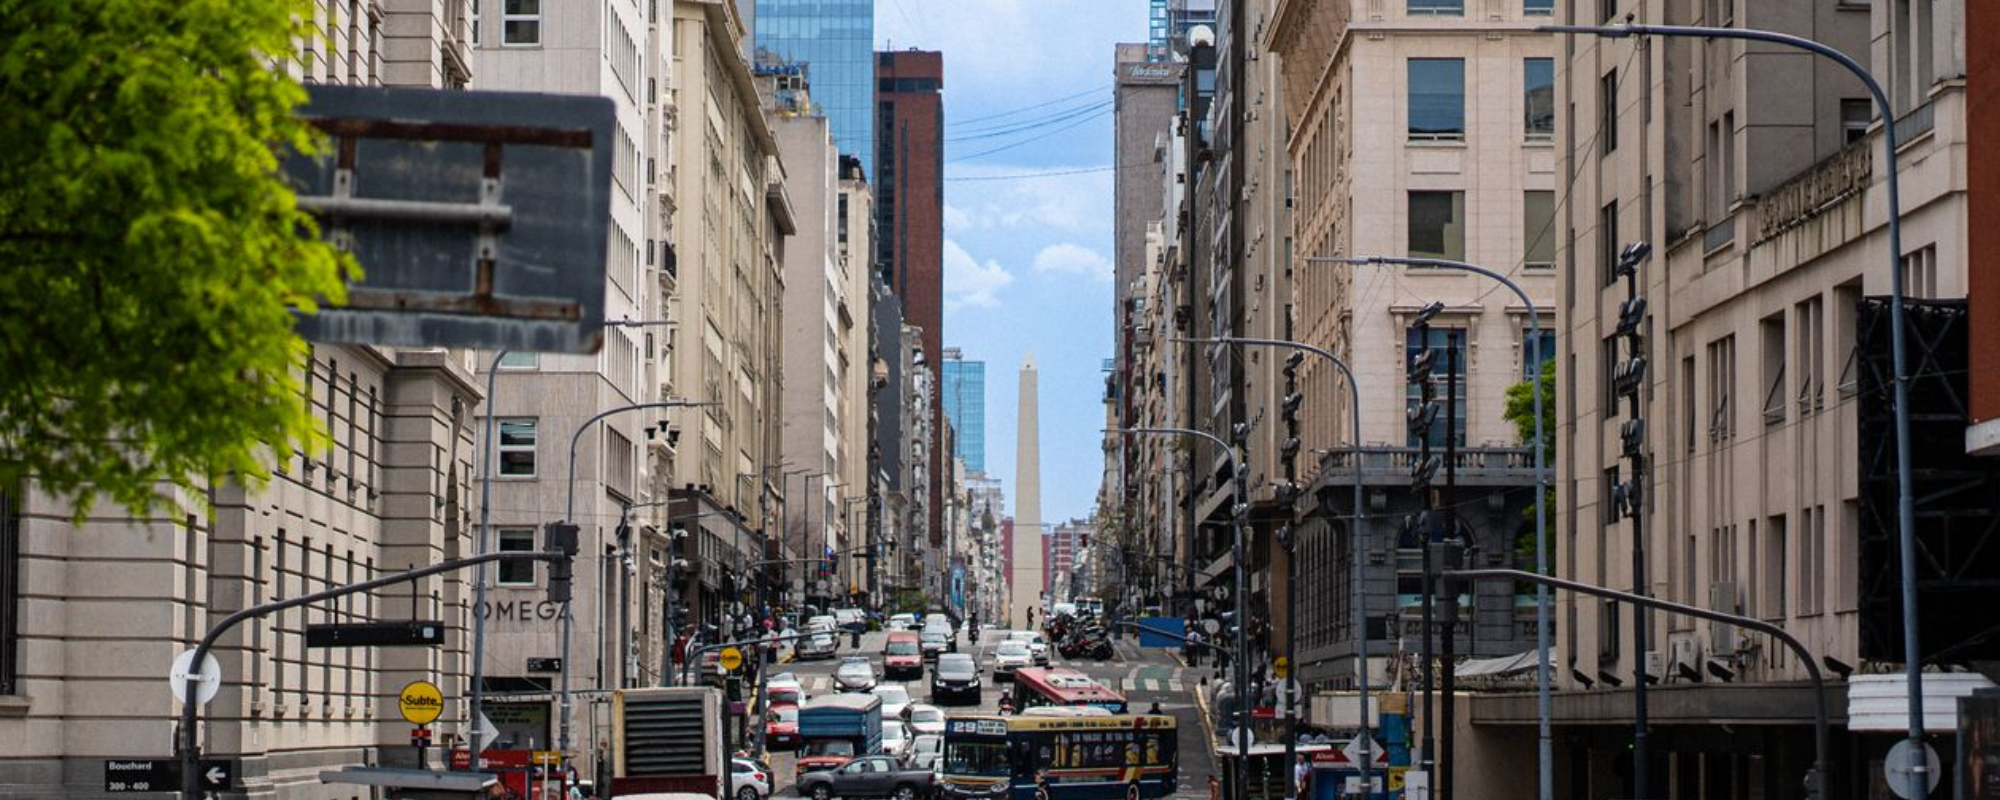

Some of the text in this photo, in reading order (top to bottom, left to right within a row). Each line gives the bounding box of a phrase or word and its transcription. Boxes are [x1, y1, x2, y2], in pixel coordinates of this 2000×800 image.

[406, 695, 437, 706] Subte
[109, 761, 152, 771] Bouchard
[109, 782, 126, 791] 300
